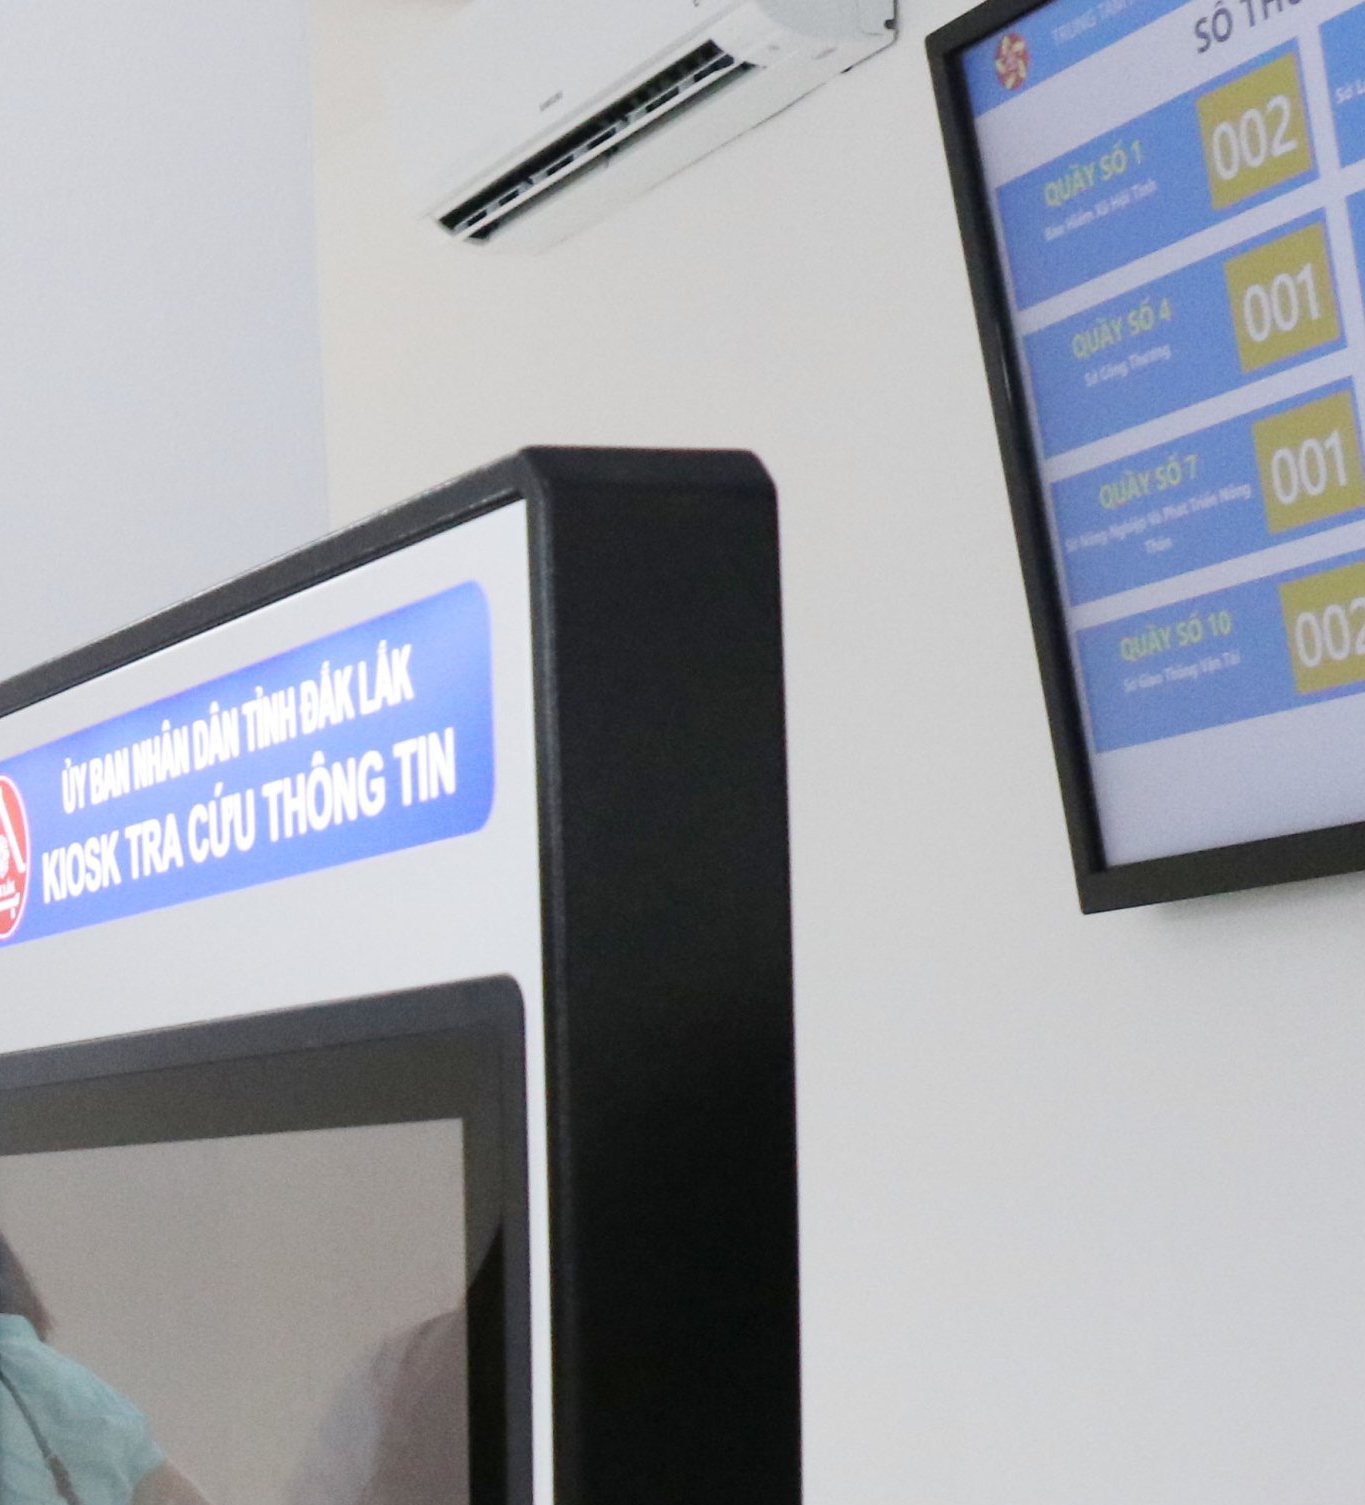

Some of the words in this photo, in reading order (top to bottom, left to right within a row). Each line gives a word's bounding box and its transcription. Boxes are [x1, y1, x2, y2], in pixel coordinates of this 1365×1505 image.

[1212, 94, 1299, 180] 002
[1158, 297, 1172, 321] 4
[1243, 262, 1321, 342] 001
[1184, 454, 1199, 479] 7
[1272, 430, 1349, 505] 001
[1207, 609, 1233, 637] 10
[1295, 597, 1365, 668] 002
[61, 757, 87, 815] ỦY
[89, 746, 131, 806] BAN
[131, 718, 191, 789] NHÂN
[192, 700, 240, 764] DÂN
[241, 685, 297, 752] TỈNH
[300, 660, 356, 735] ĐẮK
[358, 639, 415, 716] LẮK
[41, 829, 122, 904] KIOSK
[124, 812, 184, 880] TRA
[187, 781, 256, 863] CỨU
[262, 750, 386, 843] THÔNG
[392, 726, 456, 807] TIN
